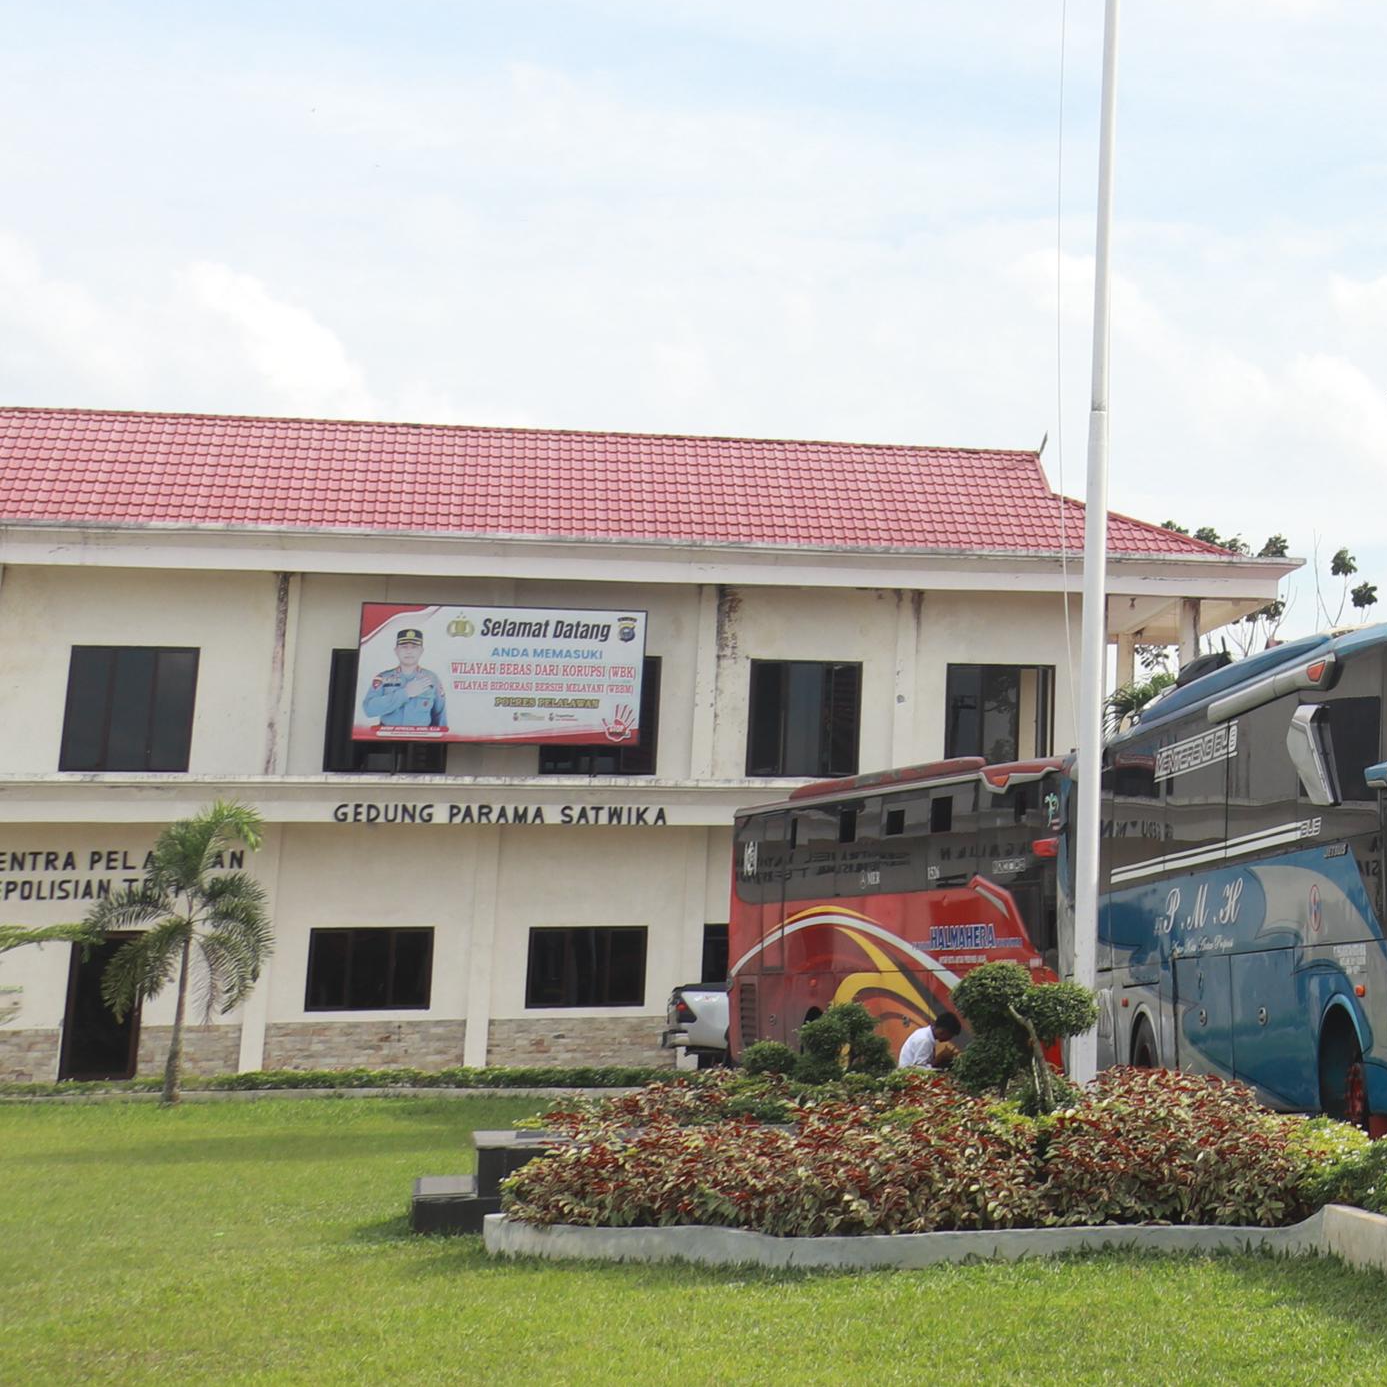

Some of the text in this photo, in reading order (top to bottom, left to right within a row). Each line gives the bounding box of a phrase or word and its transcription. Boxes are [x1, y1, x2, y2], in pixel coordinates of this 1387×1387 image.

[481, 618, 611, 642] Selamat Datang
[491, 647, 603, 660] ANDA MEMASUKI
[451, 662, 636, 679] WILAYAH BEBAS DARI KORUPSI (WBK)
[453, 680, 489, 690] WILAYAH
[494, 697, 600, 709] POLRES PELALAWAN
[334, 803, 667, 826] GEDUNG PARAMA SATWIKA
[929, 923, 997, 951] HALMAHERA
